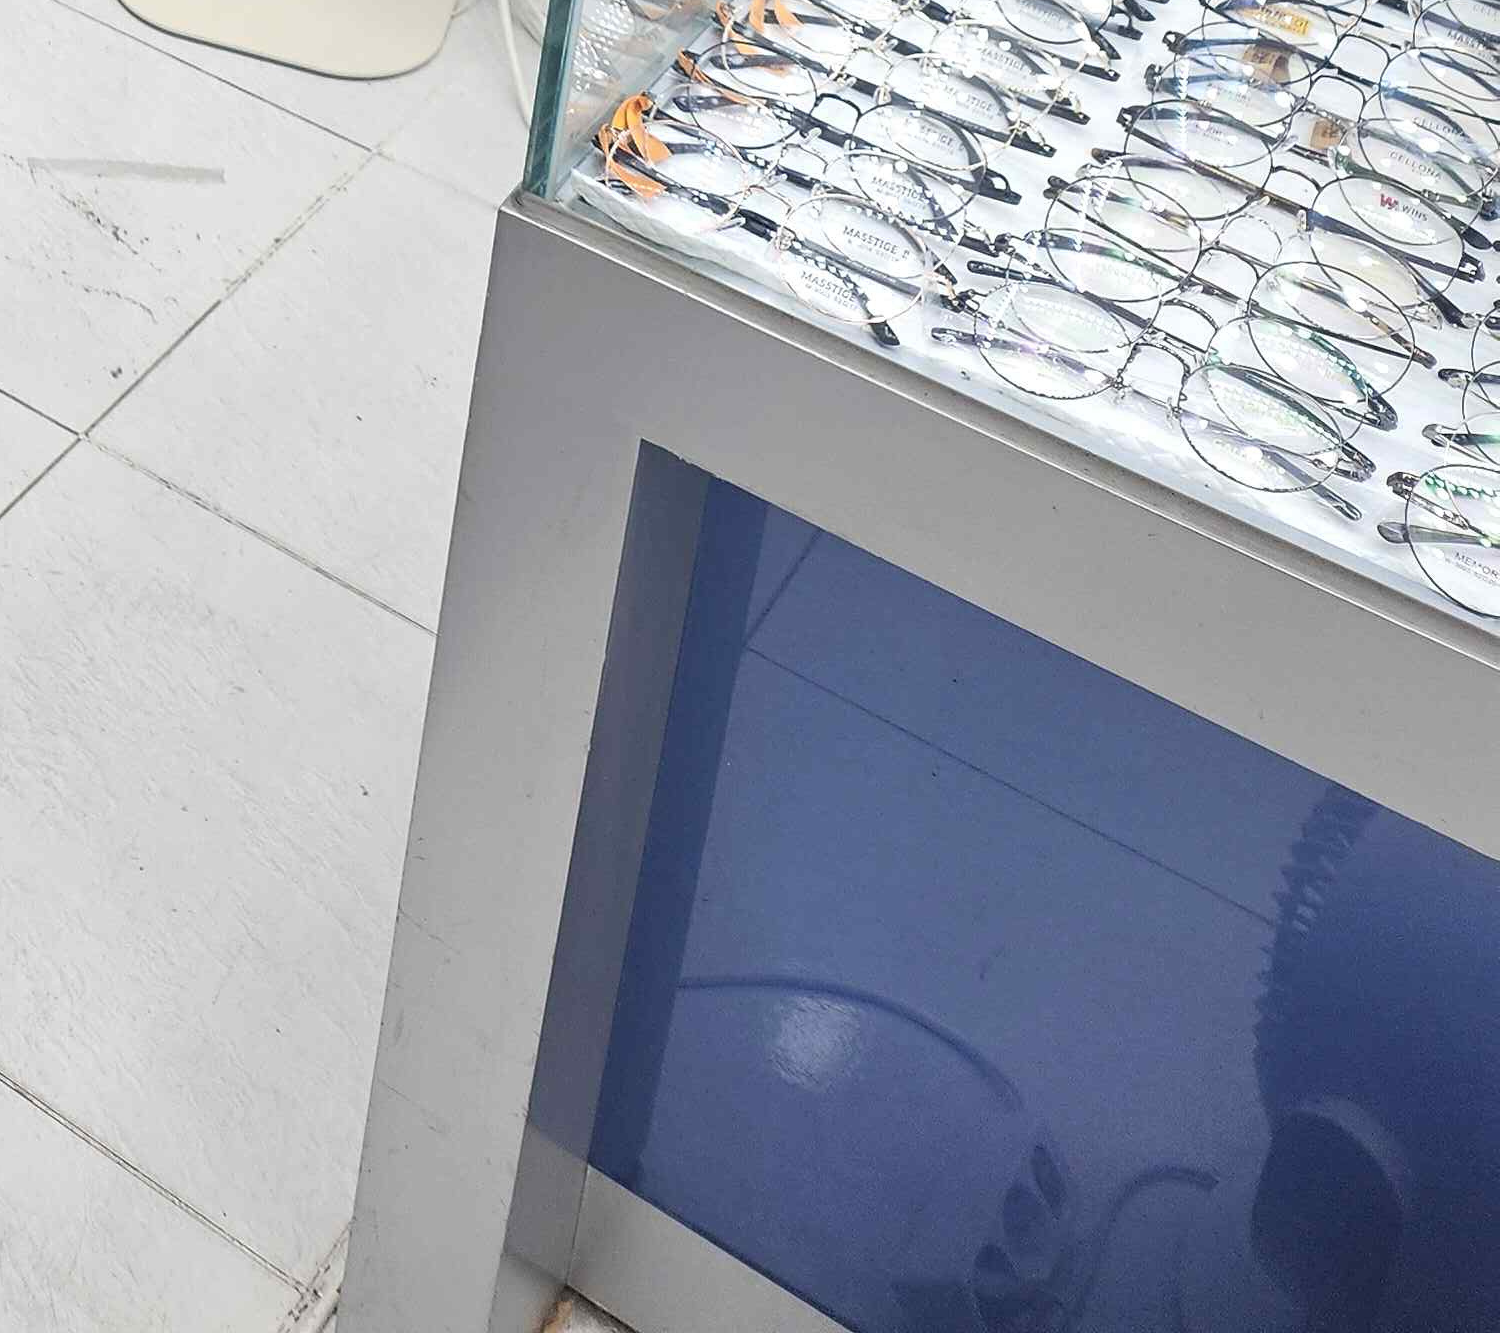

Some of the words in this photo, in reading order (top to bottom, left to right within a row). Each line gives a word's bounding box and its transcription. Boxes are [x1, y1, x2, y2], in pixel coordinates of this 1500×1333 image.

[842, 225, 899, 255] MASSTIGE
[800, 270, 858, 304] MASSTIGE
[1454, 551, 1500, 581] MEMOR
